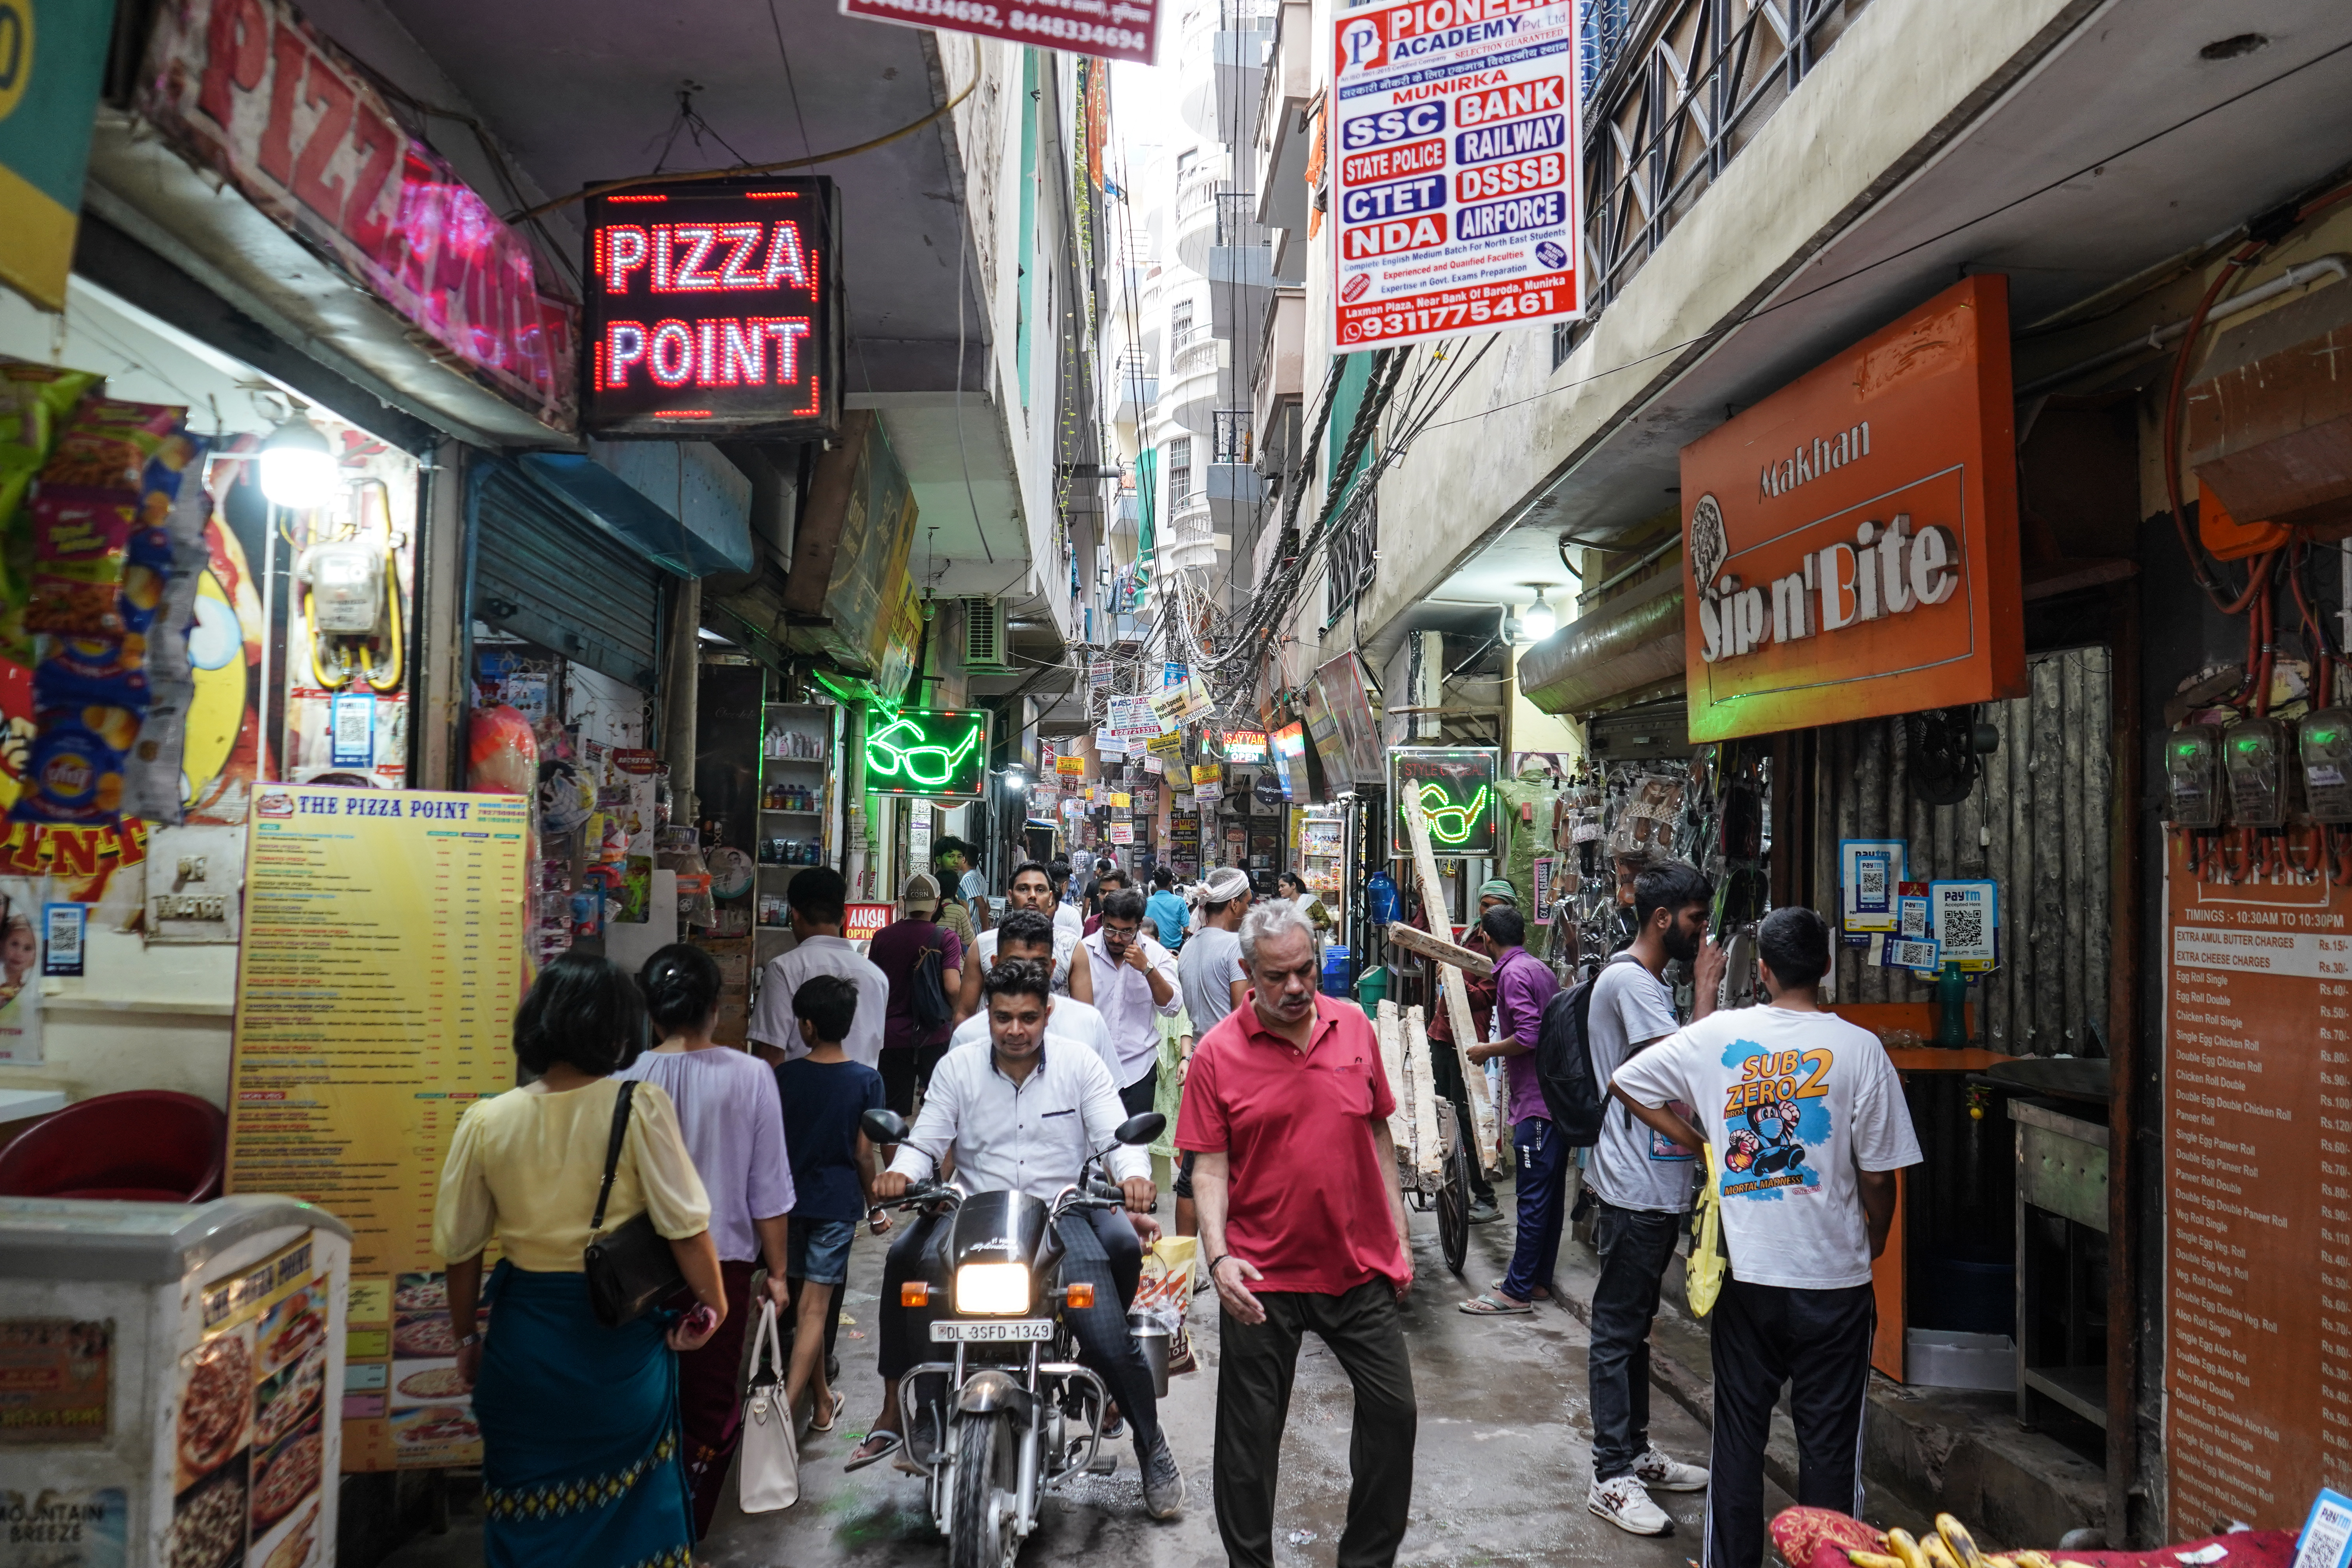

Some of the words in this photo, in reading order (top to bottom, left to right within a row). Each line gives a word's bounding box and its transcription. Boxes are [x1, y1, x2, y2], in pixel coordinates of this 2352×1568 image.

[860, 0, 1003, 29] 8334692,
[1390, 0, 1559, 40] PIONE
[1394, 15, 1524, 60] ACADEMY
[1523, 19, 1543, 32] Pvt.
[1548, 13, 1569, 26] Ltd.
[1455, 42, 1503, 59] SELECTION
[1504, 29, 1564, 49] GUARANTEED
[1341, 82, 1378, 98] सरकारी
[1379, 74, 1410, 89] नौकरी
[1412, 71, 1423, 83] के
[1425, 67, 1445, 81] लिए
[1540, 42, 1568, 55] स्थान
[1392, 62, 1417, 71] Certified
[1418, 55, 1447, 67] Company
[1392, 69, 1508, 105] MUNIRKA
[1461, 78, 1562, 125] BANK
[1348, 104, 1439, 148] SSC
[1464, 116, 1562, 163] RAILWAY
[1346, 152, 1388, 182] STATE
[1392, 143, 1443, 172] POLICE
[1462, 156, 1560, 200] DSSSB
[1348, 178, 1436, 221] CTET
[1461, 194, 1558, 240] AIRFORCE
[1345, 260, 1380, 272] Complete
[1382, 254, 1410, 267] English
[1412, 250, 1443, 261] Medium
[1445, 245, 1467, 257] Batch
[1469, 243, 1483, 252] For
[1485, 239, 1508, 251] North
[1510, 236, 1528, 247] East
[1530, 229, 1566, 245] Students
[1352, 217, 1441, 258] NDA
[606, 220, 811, 294] PIZZA
[1383, 266, 1431, 281] Experienced
[1433, 261, 1448, 271] and
[1487, 250, 1524, 263] Faculties
[1381, 281, 1418, 294] Expertise
[1429, 275, 1449, 287] Govt.
[1452, 271, 1478, 282] Exams
[1480, 263, 1527, 278] Preparation
[1346, 304, 1383, 319] Laxman
[1385, 299, 1414, 313] Plaza,
[1417, 296, 1440, 308] Near
[1442, 291, 1467, 304] Bank
[1469, 289, 1481, 299] Of
[1483, 283, 1522, 298] Baroda,
[1524, 276, 1566, 291] Munirka
[1362, 290, 1554, 337] 9311775461
[606, 316, 809, 387] POINT
[1759, 421, 1869, 504] Makhan
[1699, 575, 1769, 663] Sip
[1154, 703, 1166, 713] High
[1166, 695, 1183, 708] Speed
[1167, 684, 1188, 695] BROADBAND
[1158, 702, 1186, 720] Broadband
[1178, 705, 1212, 726] 9953500424
[1114, 726, 1159, 736] 8287213376
[1227, 733, 1265, 745] SAYYAM
[1231, 753, 1259, 761] OPEN
[1405, 764, 1437, 776] STYLE
[299, 796, 338, 814] THE
[345, 798, 402, 817] PIZZA
[410, 801, 469, 819] POINT
[1539, 864, 1548, 890] CLASSES
[849, 909, 886, 928] ANSH
[2185, 909, 2224, 922] TIMINGS
[2237, 913, 2278, 925] 10:30AM
[2281, 914, 2296, 926] TO
[2299, 914, 2344, 928] 10:30PM
[2177, 931, 2200, 942] EXTRA
[2201, 933, 2221, 944] AMUL
[2223, 934, 2253, 946] BUTTER
[2255, 936, 2294, 949] CHARGES
[2319, 939, 2348, 951] Rs.15/-
[2177, 951, 2200, 963] EXTRA
[2201, 953, 2230, 965] CHEESE
[2232, 955, 2270, 968] CHARGES
[2319, 962, 2348, 974] Rs.30/-
[2176, 970, 2189, 982] Egg
[2191, 972, 2204, 983] Roll
[2207, 974, 2227, 986] Single
[2319, 984, 2349, 996] Rs.40/-
[2176, 991, 2189, 1004] Egg
[2191, 992, 2204, 1003] Roll
[2207, 994, 2230, 1006] Double
[1742, 1050, 1798, 1082] SUB
[1795, 1048, 1833, 1099] 2
[1725, 1076, 1797, 1112] ZERO
[1726, 1109, 1746, 1118] BROS.
[1724, 1182, 1759, 1196] MORTAL
[1760, 1175, 1803, 1192] MADNESS!
[1794, 1185, 1821, 1194] OUTWORLD
[2176, 1208, 2188, 1223] Veg
[2190, 1212, 2204, 1226] Roll
[2206, 1217, 2228, 1232] Single
[947, 1327, 964, 1339] DL
[971, 1325, 1006, 1339] 3SFD
[1014, 1325, 1049, 1339] 1349
[2176, 1408, 2213, 1433] Mushroom
[10, 1523, 82, 1543] BREEZE
